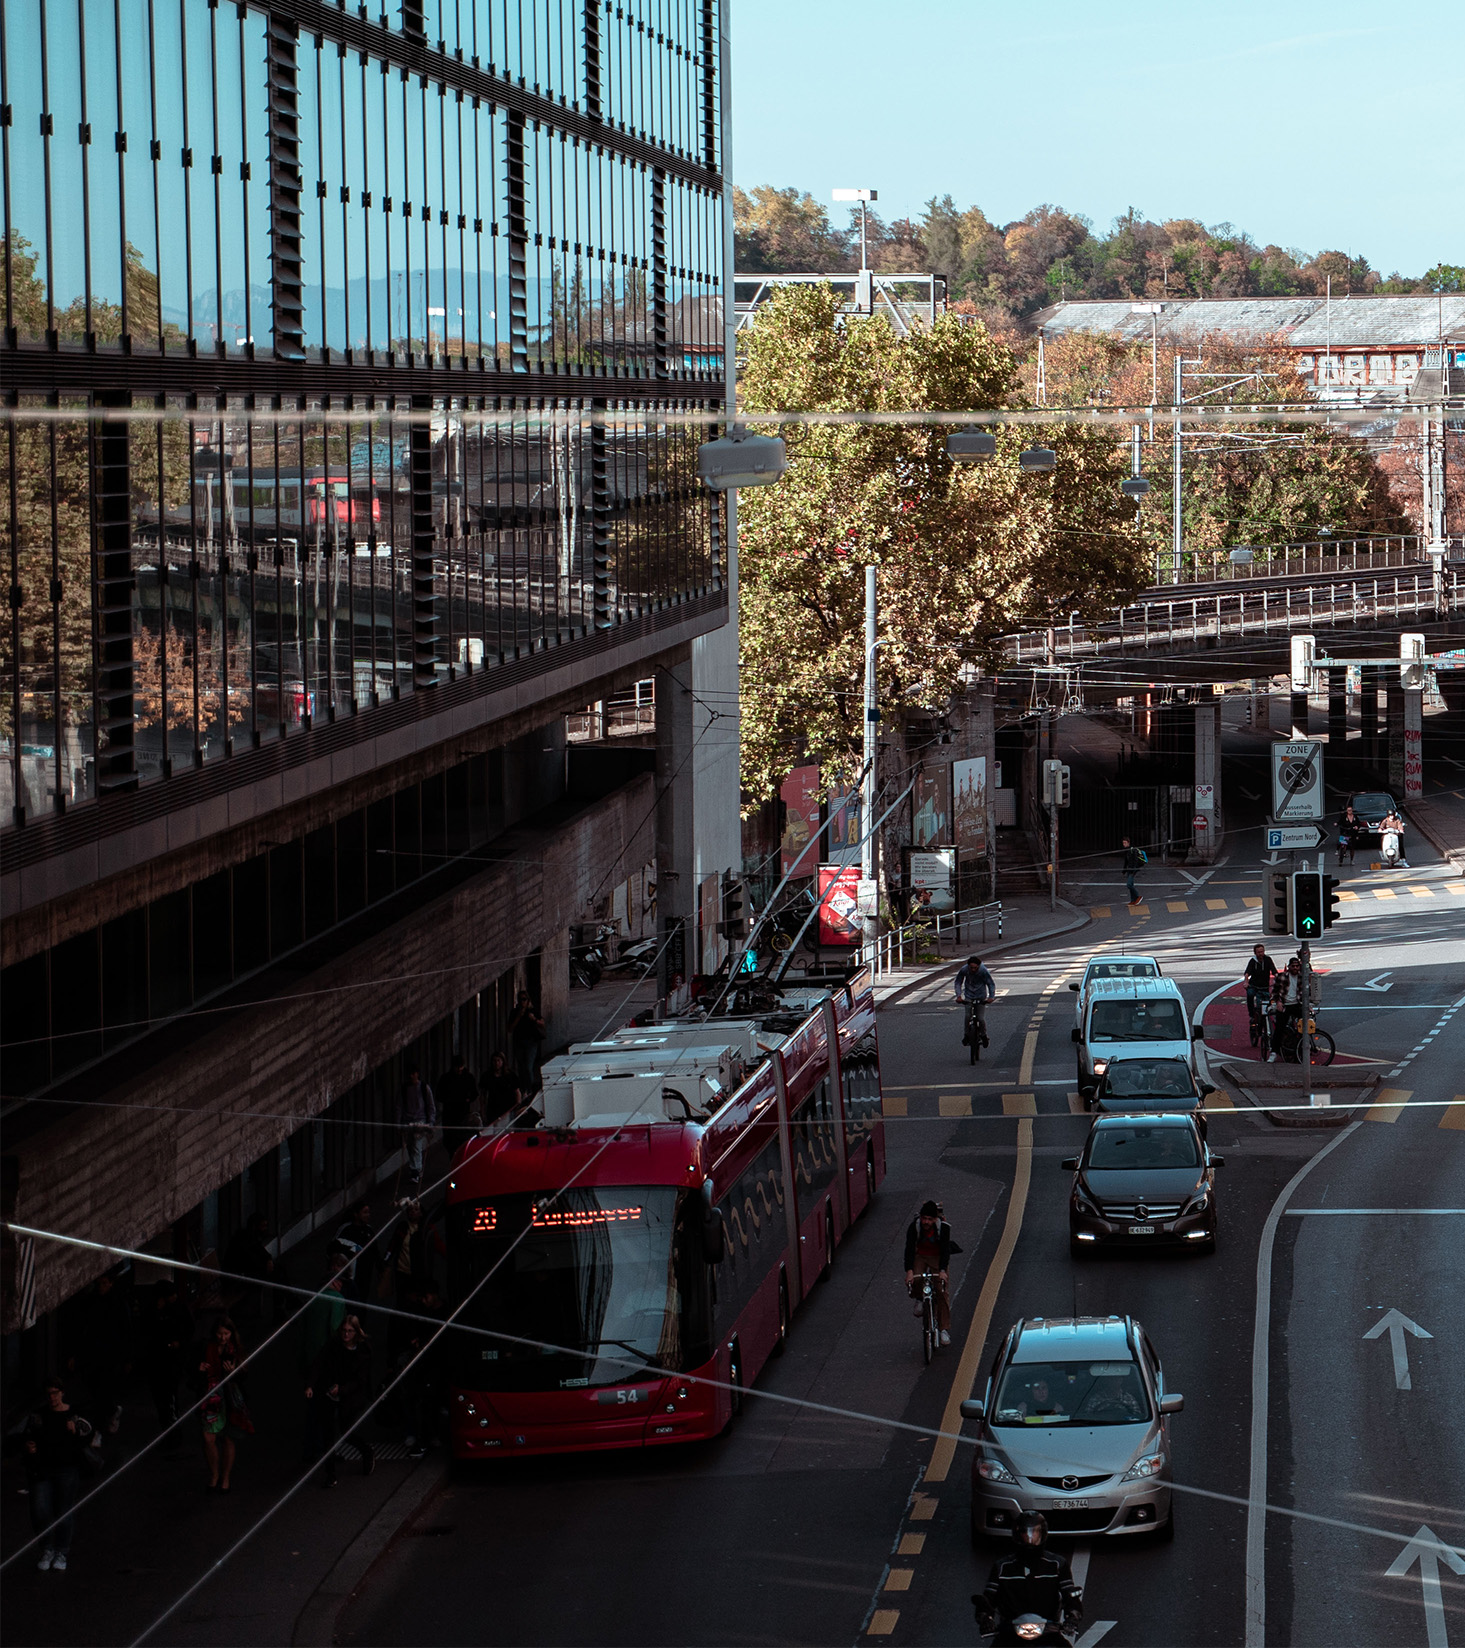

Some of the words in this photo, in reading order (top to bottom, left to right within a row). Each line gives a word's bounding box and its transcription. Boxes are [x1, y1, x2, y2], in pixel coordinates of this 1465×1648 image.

[1286, 746, 1308, 754] ZONE
[1282, 834, 1304, 842] Zentrum
[559, 1378, 588, 1387] HESS
[616, 1389, 638, 1404] 54
